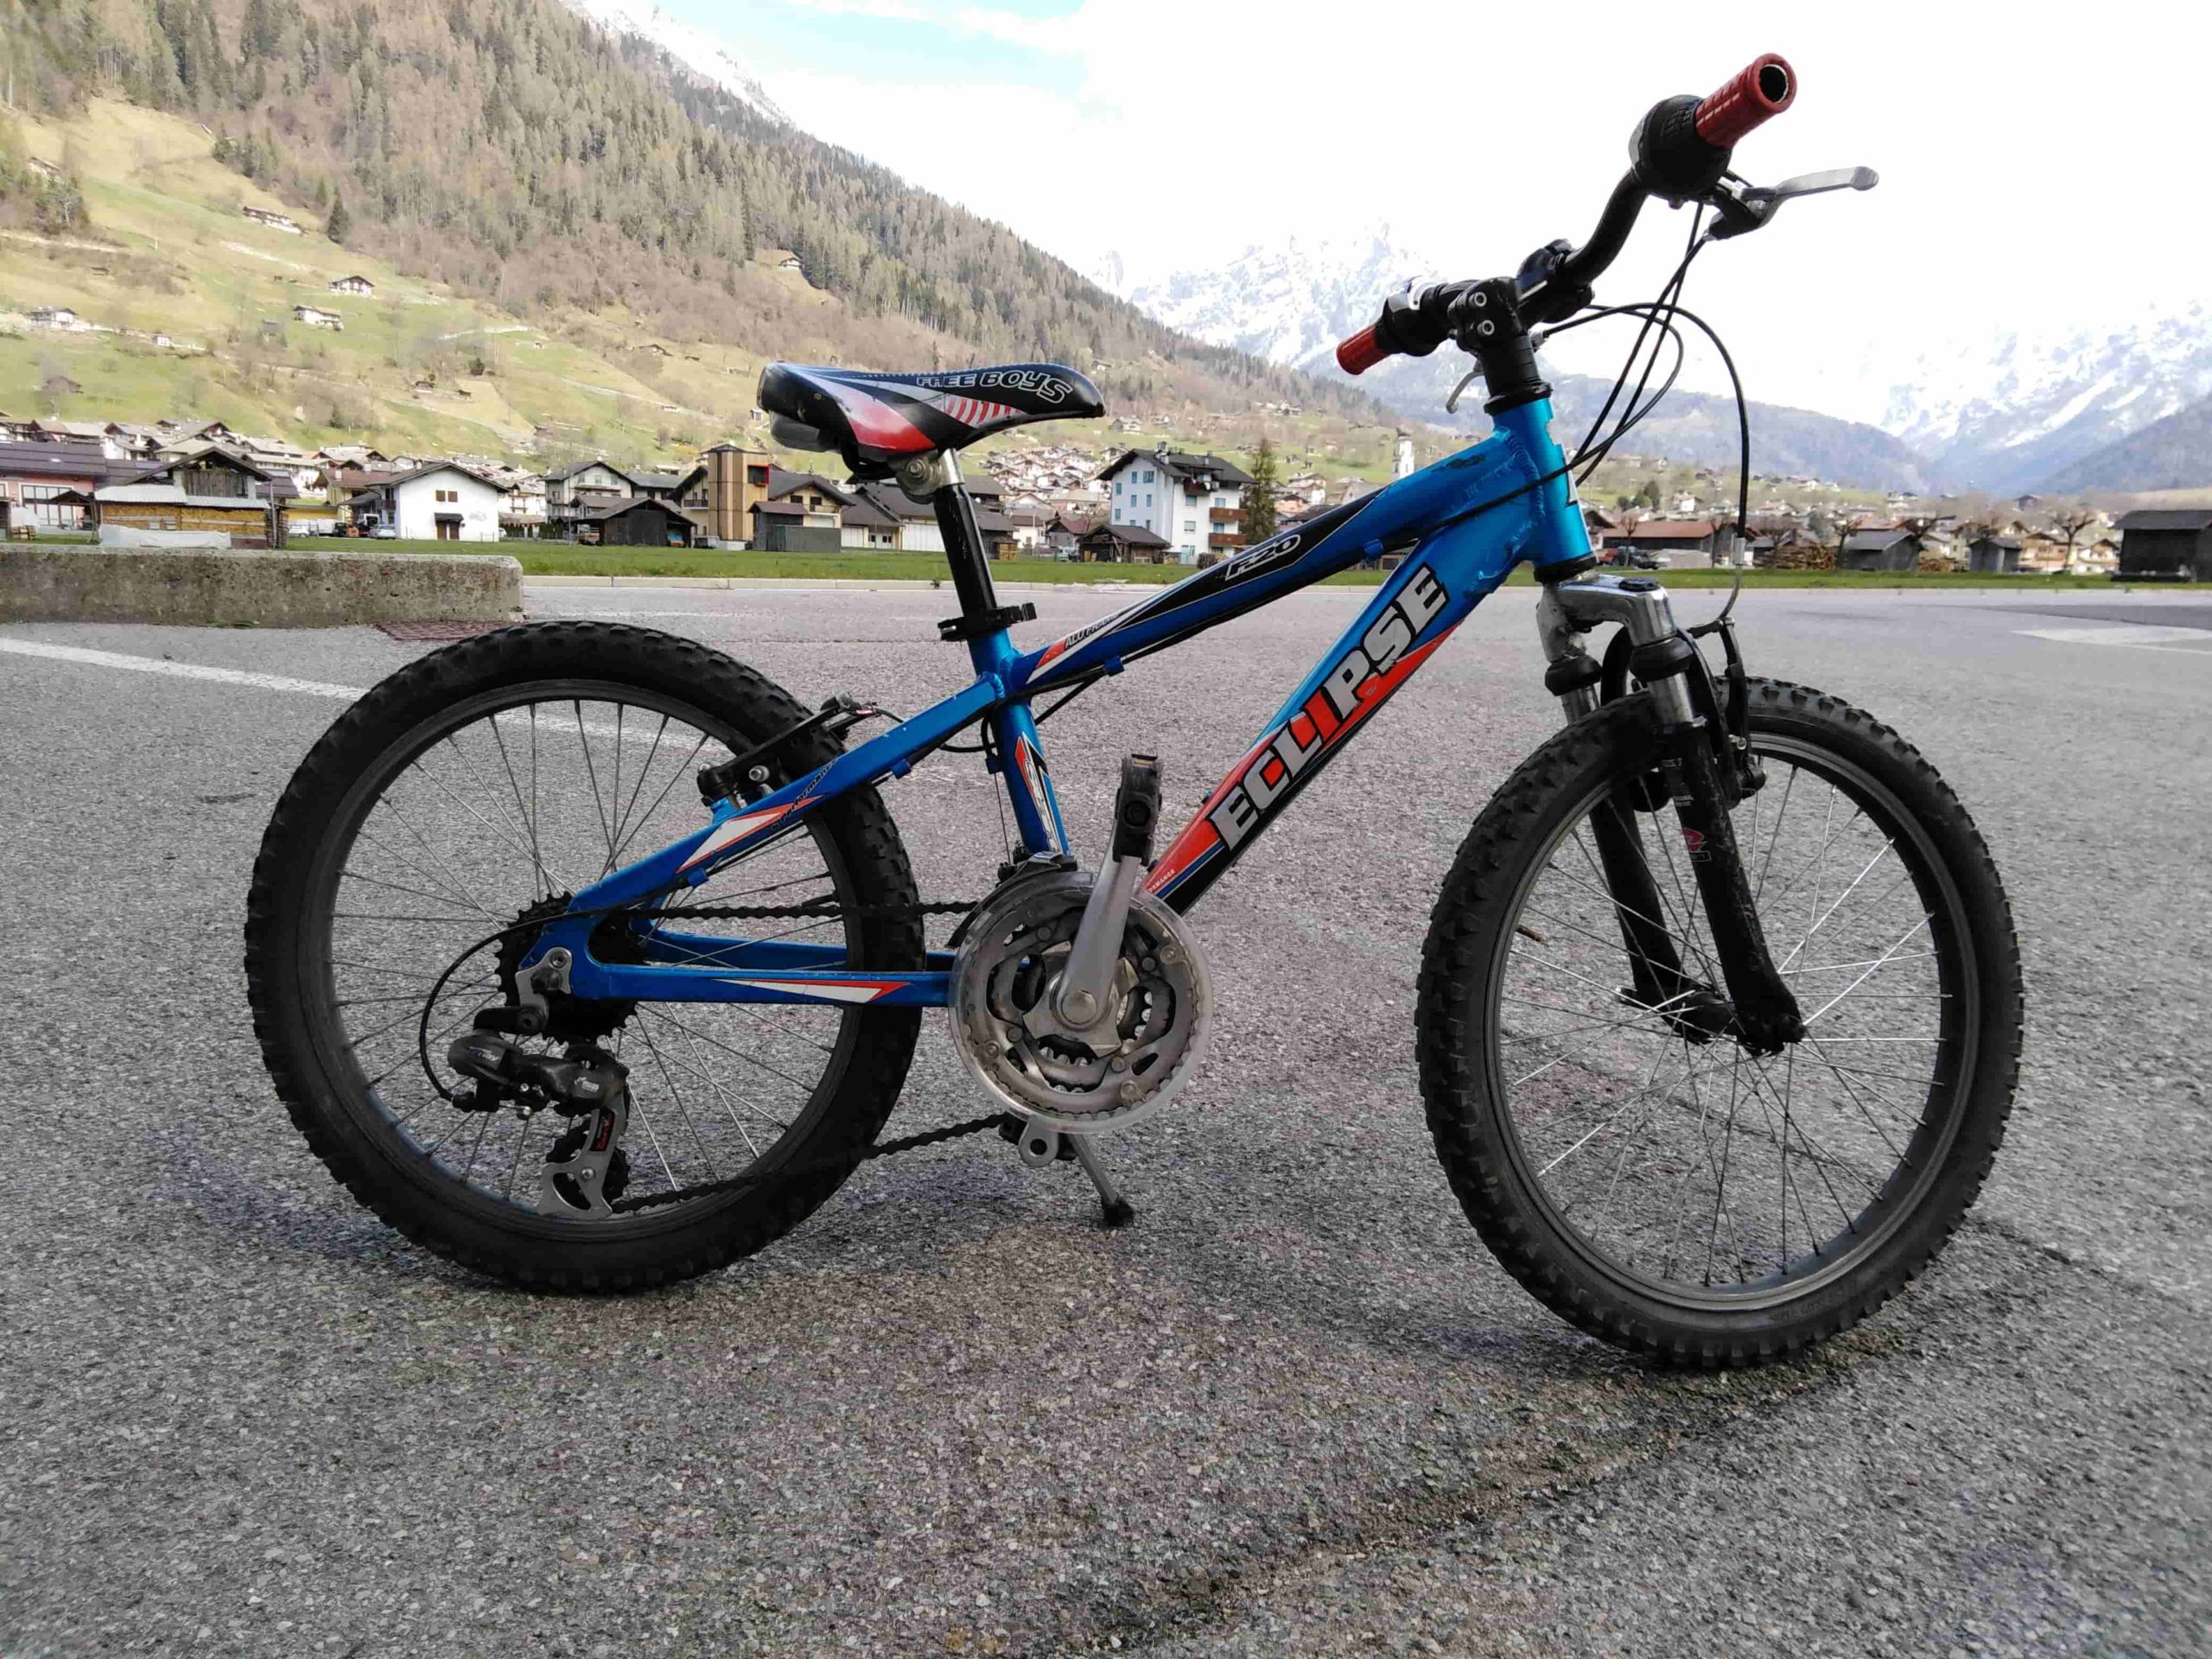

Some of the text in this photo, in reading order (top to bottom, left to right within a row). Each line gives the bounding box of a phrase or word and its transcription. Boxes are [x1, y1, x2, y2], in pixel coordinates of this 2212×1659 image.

[916, 370, 1073, 404] FREE BOYS
[1205, 562, 1451, 851] ECLIPSE
